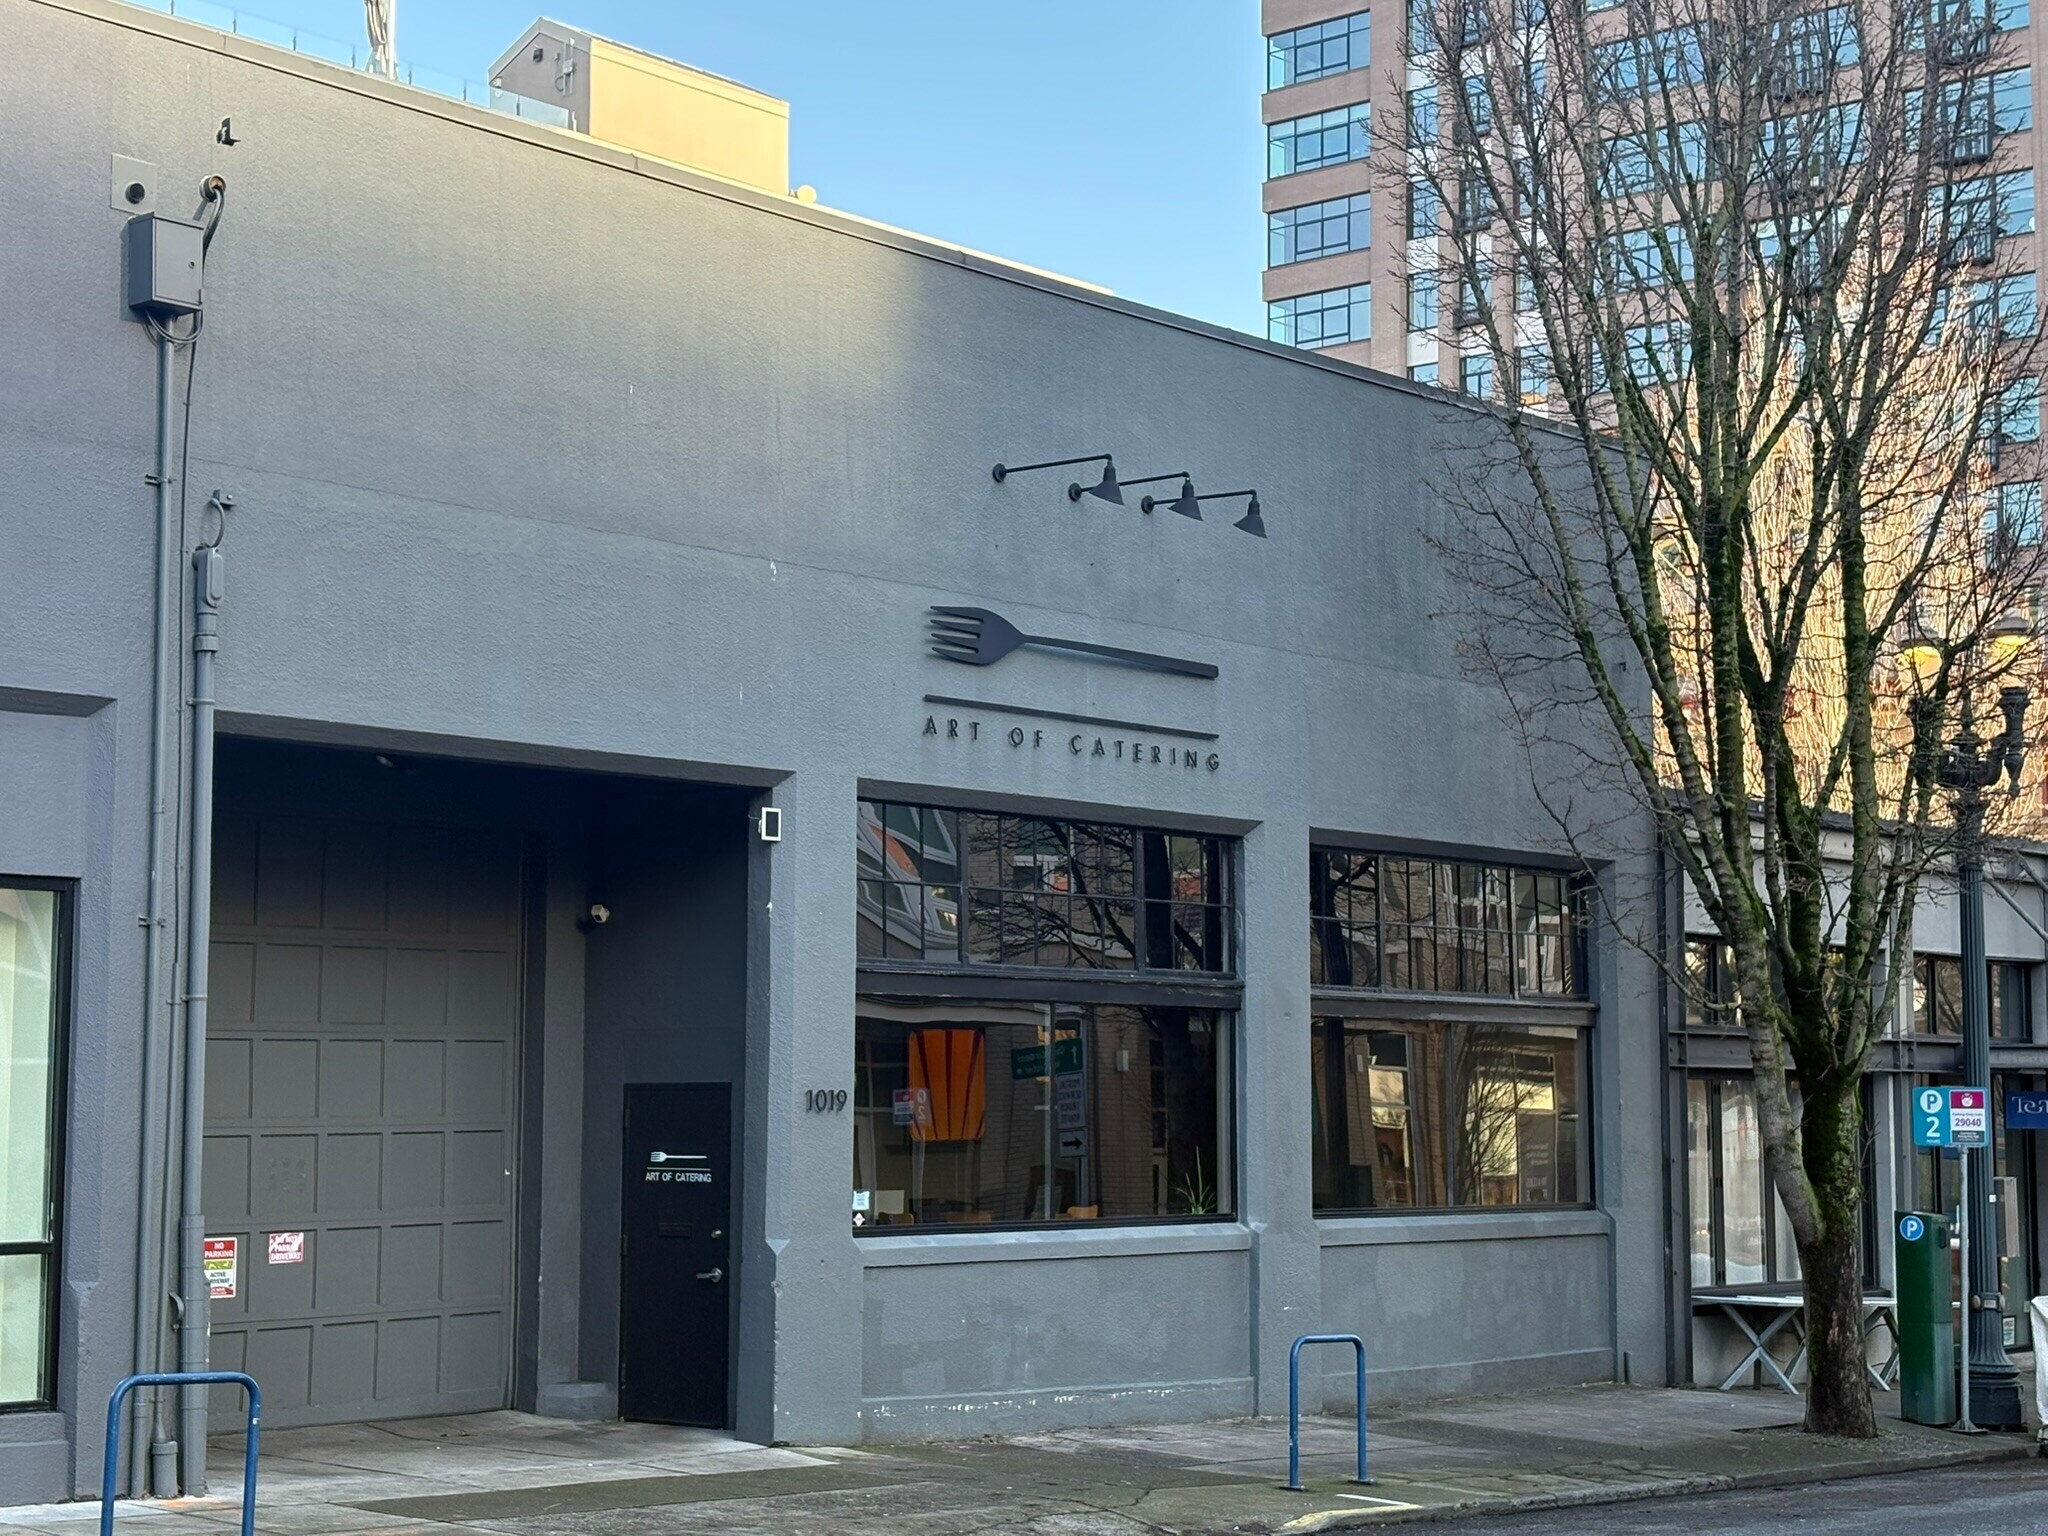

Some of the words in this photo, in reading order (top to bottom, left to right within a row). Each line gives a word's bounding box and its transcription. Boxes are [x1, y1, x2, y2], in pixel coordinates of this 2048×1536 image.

[923, 715, 980, 741] ART
[1008, 727, 1044, 749] OF
[1069, 734, 1220, 771] CATERING
[805, 1088, 848, 1113] 1019
[1926, 1094, 1938, 1109] P
[1926, 1116, 1941, 1138] 2
[1954, 1117, 1982, 1127] 29040
[645, 1172, 660, 1182] ART
[662, 1172, 673, 1183] OF
[675, 1172, 712, 1183] CATERING
[1906, 1220, 1917, 1237] P
[214, 1242, 224, 1250] NO
[204, 1250, 234, 1258] PARKING
